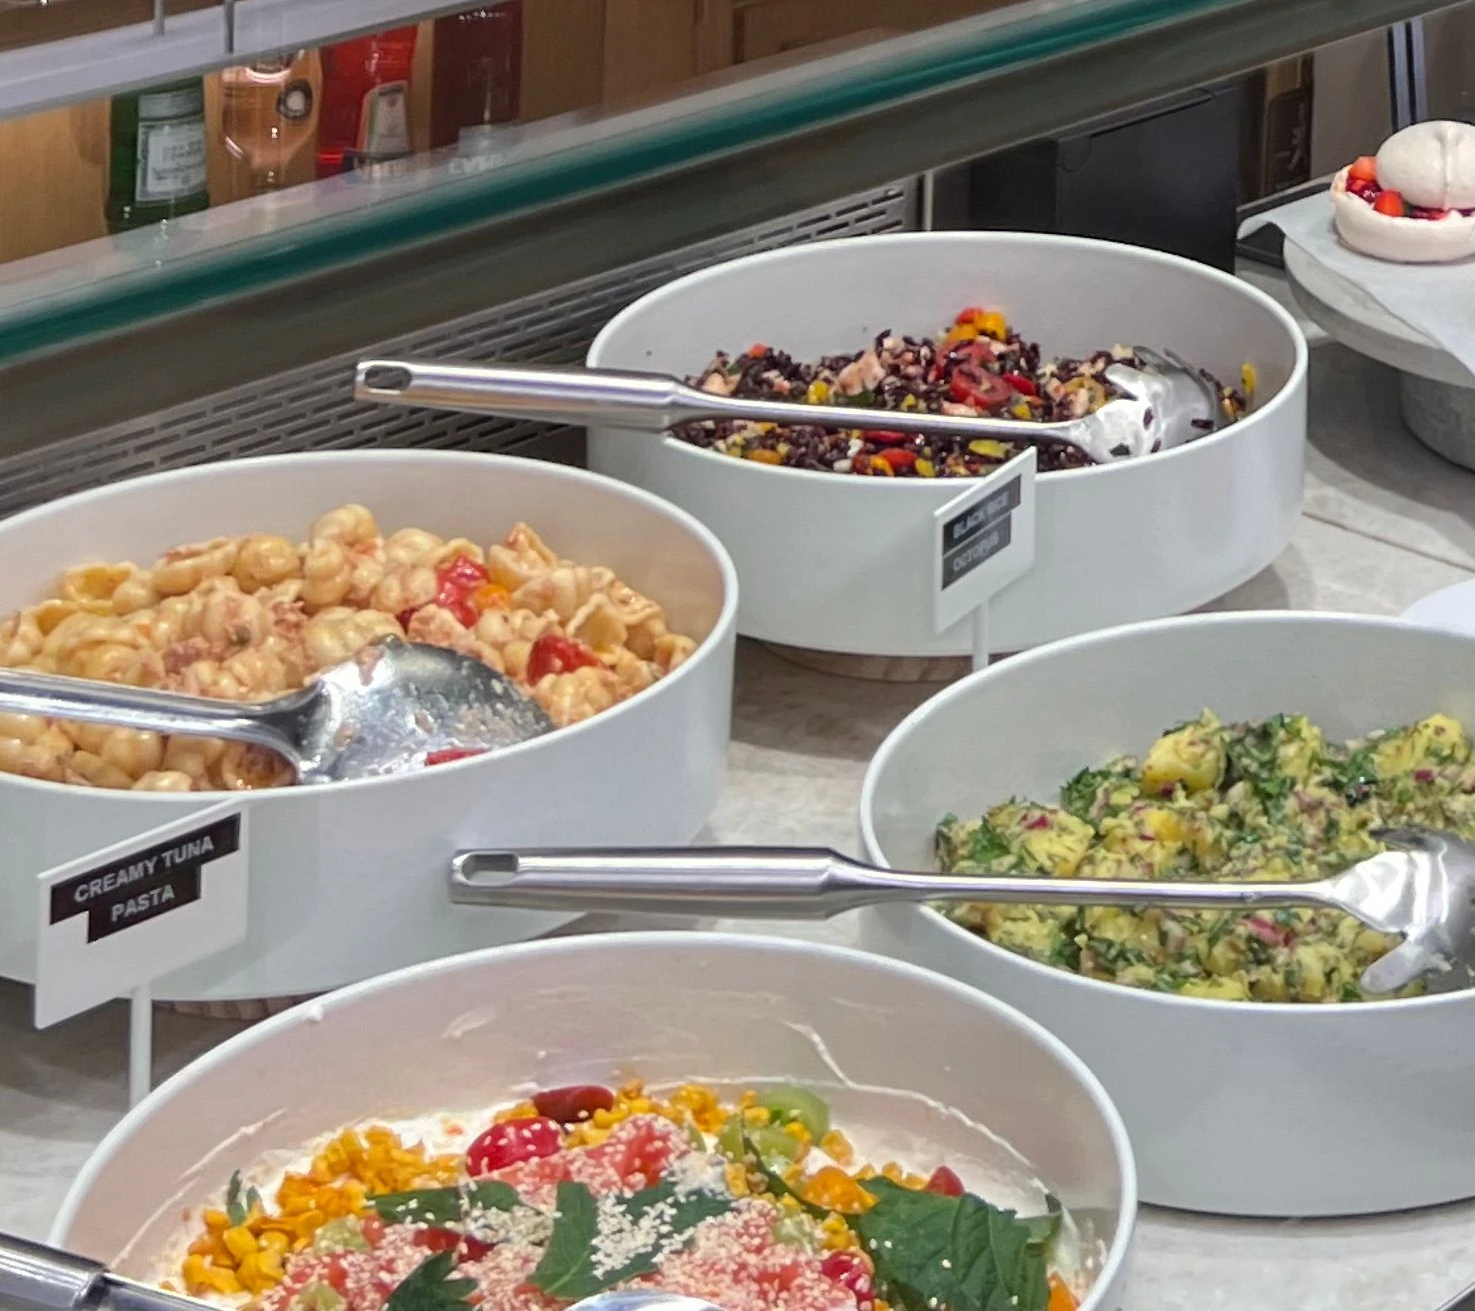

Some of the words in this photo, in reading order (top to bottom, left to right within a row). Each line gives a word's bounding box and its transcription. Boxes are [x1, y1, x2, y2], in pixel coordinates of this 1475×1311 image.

[74, 856, 157, 902] CREAMY
[162, 836, 214, 867] TUNA
[111, 884, 175, 922] PASTA
